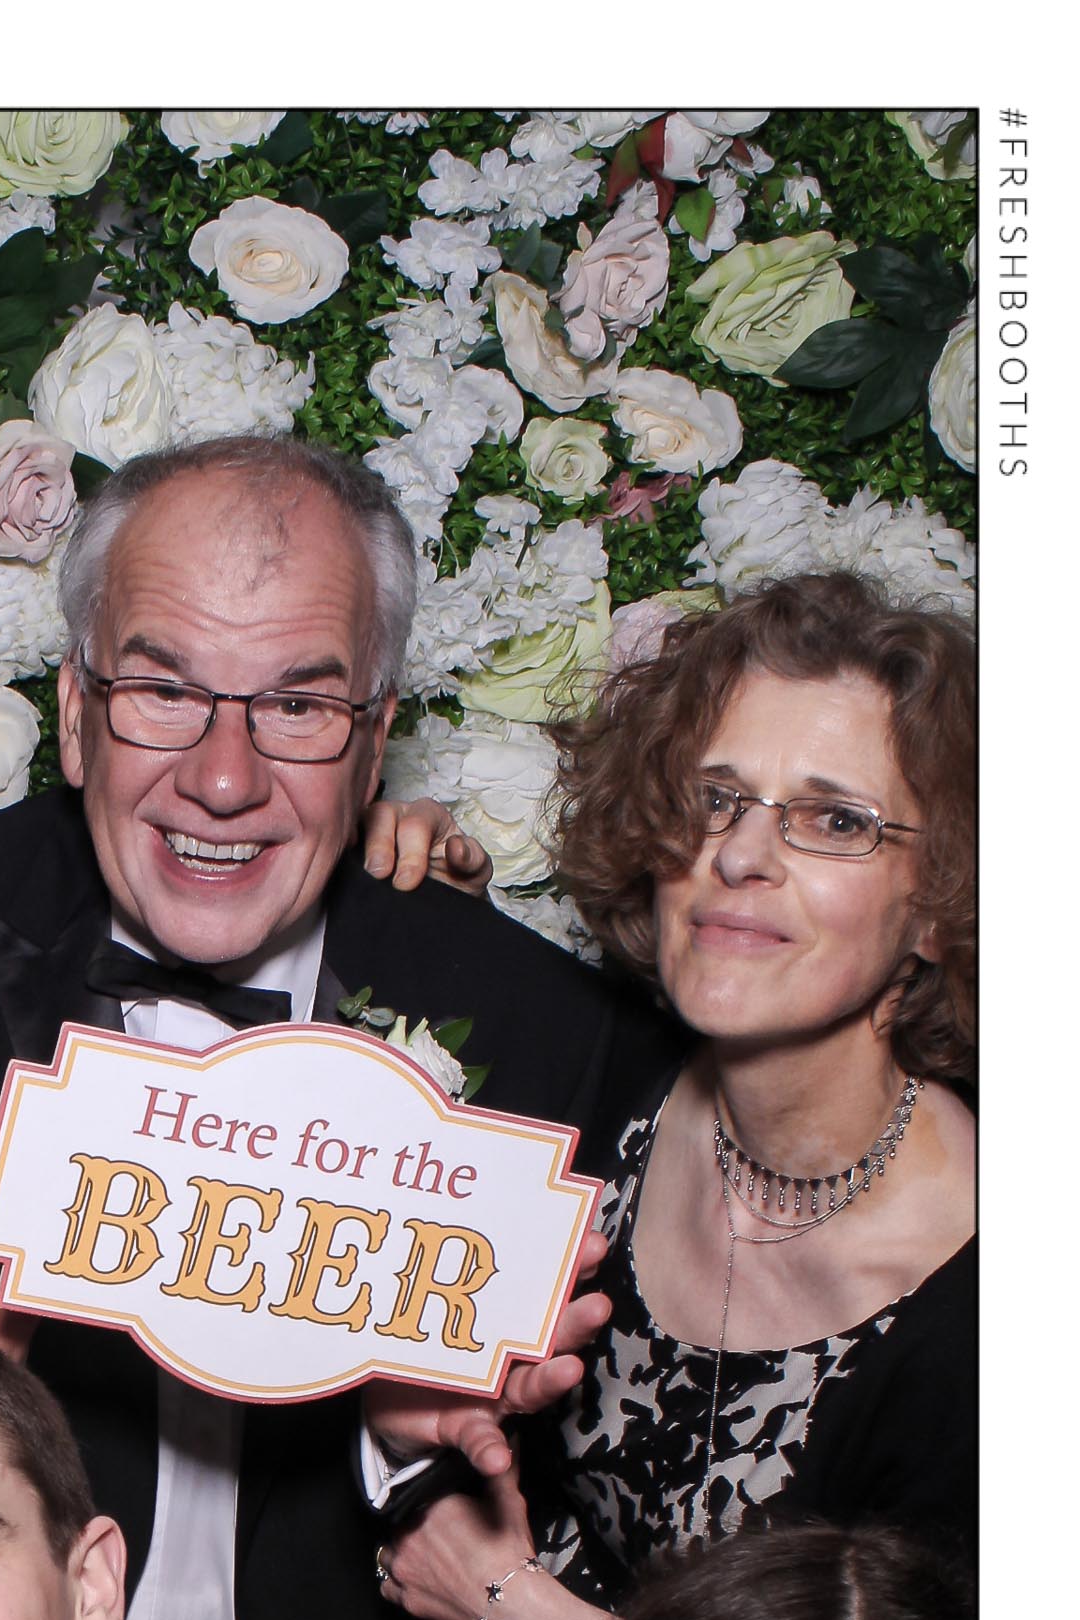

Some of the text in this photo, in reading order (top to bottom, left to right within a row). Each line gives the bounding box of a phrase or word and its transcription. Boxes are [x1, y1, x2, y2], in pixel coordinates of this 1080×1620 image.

[133, 1084, 478, 1199] Here for the
[43, 1152, 500, 1352] BEER
